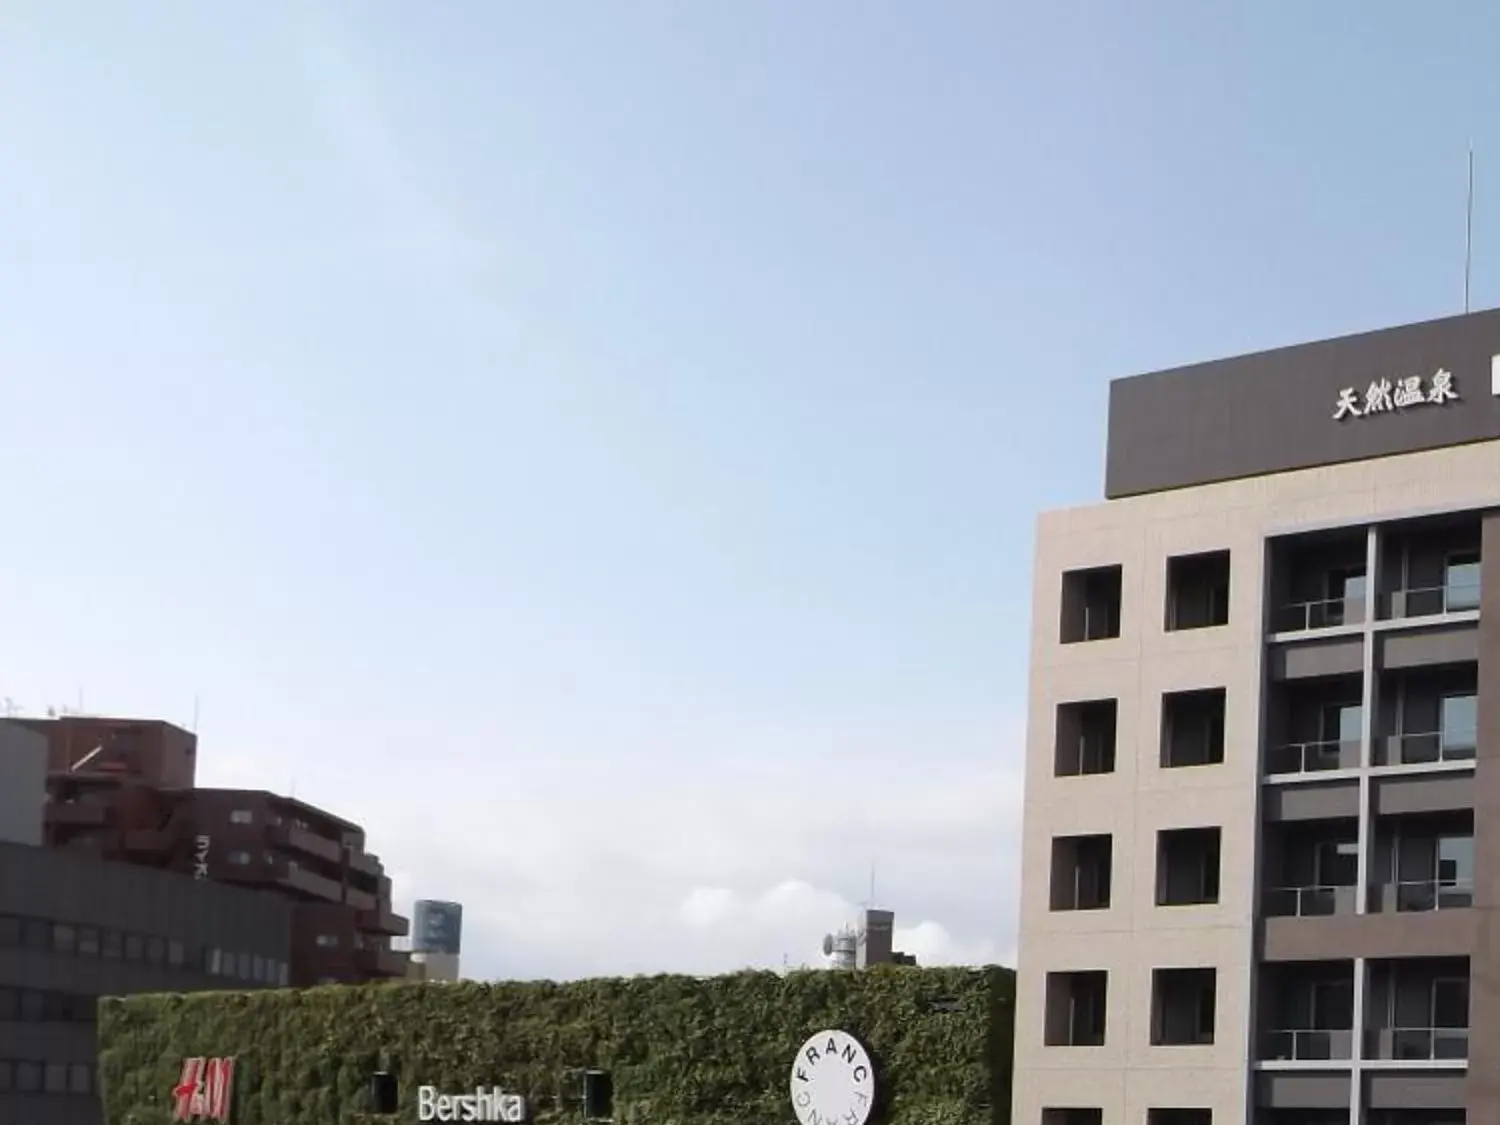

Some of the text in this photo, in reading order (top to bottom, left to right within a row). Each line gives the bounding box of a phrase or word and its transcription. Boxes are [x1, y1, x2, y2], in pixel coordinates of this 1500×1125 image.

[1332, 367, 1460, 419] 天然温泉
[418, 1085, 525, 1122] Bershka
